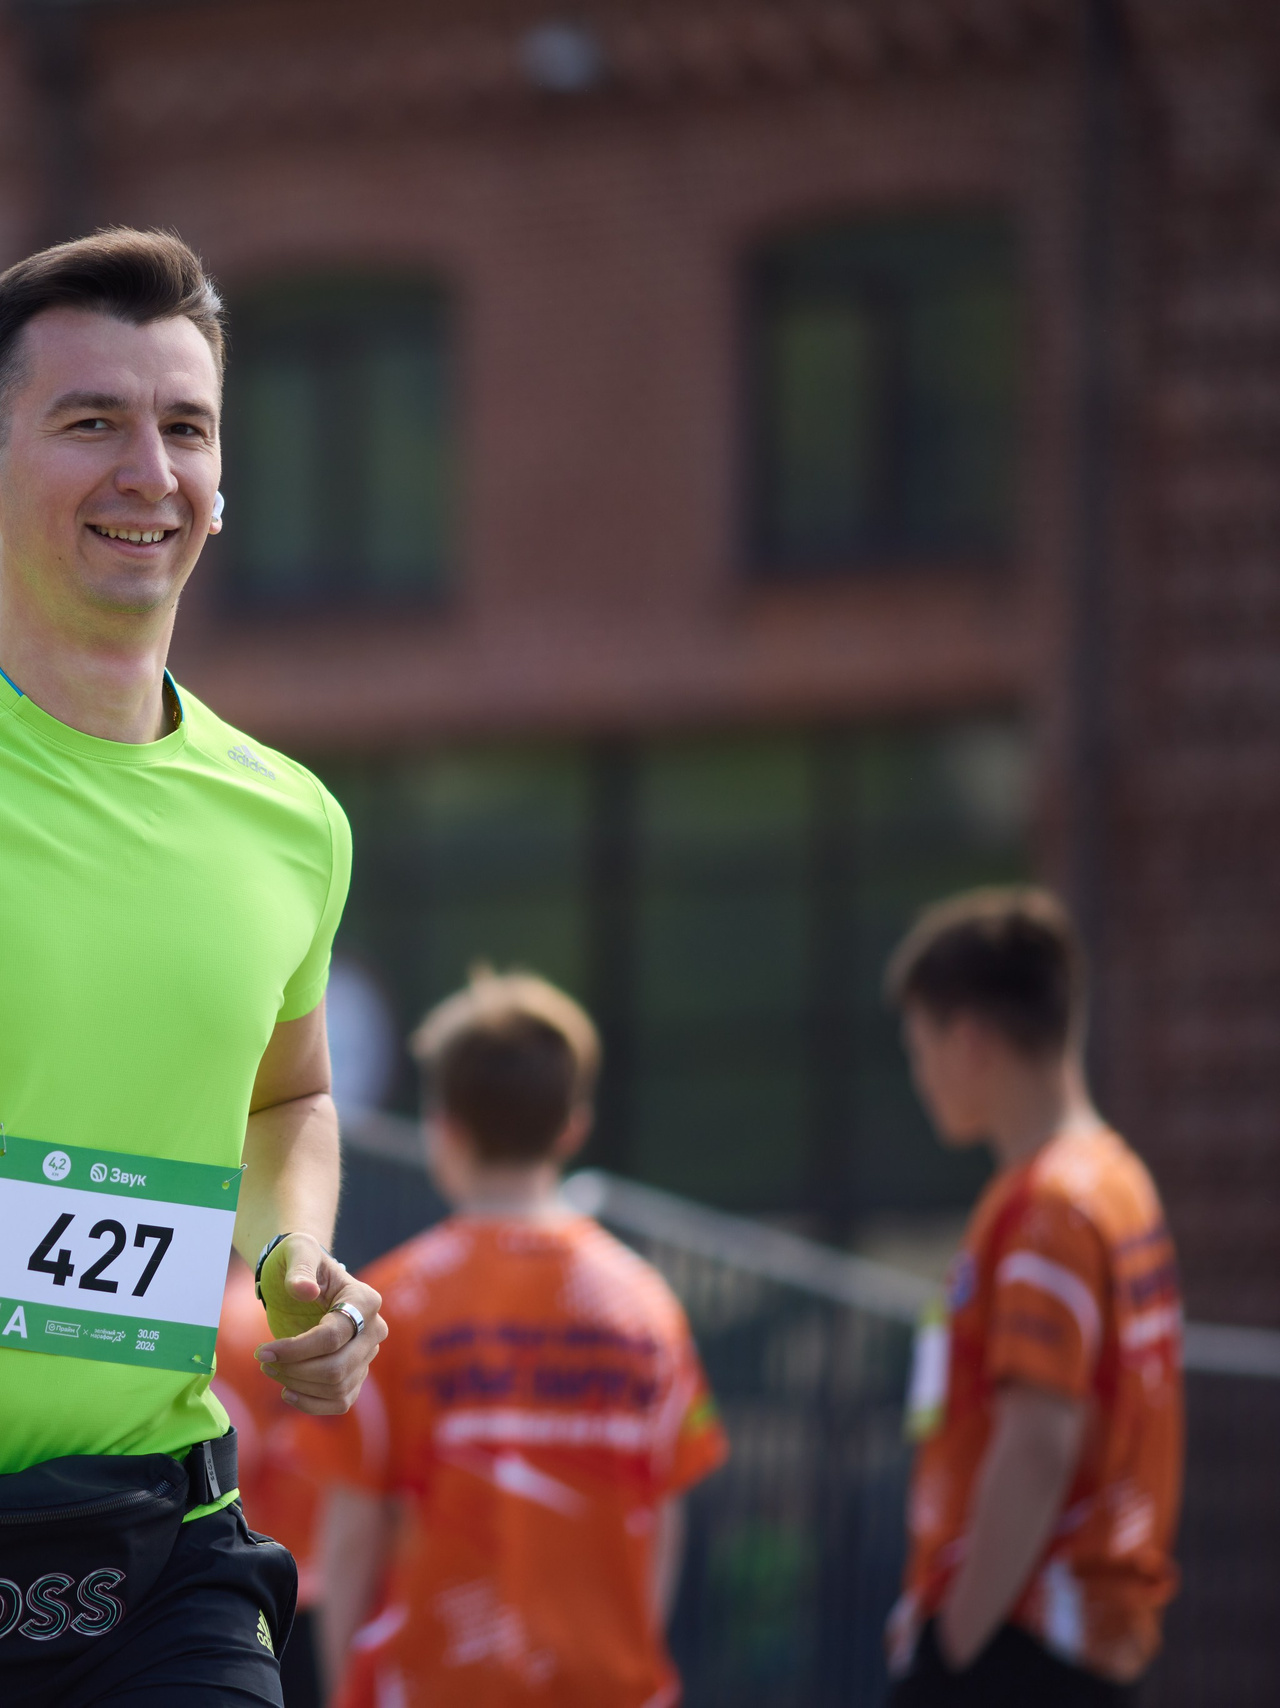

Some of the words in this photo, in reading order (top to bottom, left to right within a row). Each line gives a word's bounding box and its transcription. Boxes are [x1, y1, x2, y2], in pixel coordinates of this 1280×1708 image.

[227, 749, 276, 781] adidas
[48, 1156, 67, 1170] 4,2
[109, 1167, 146, 1187] Звук
[27, 1213, 174, 1297] 427
[137, 1328, 160, 1340] 30.05
[135, 1340, 155, 1351] 2026
